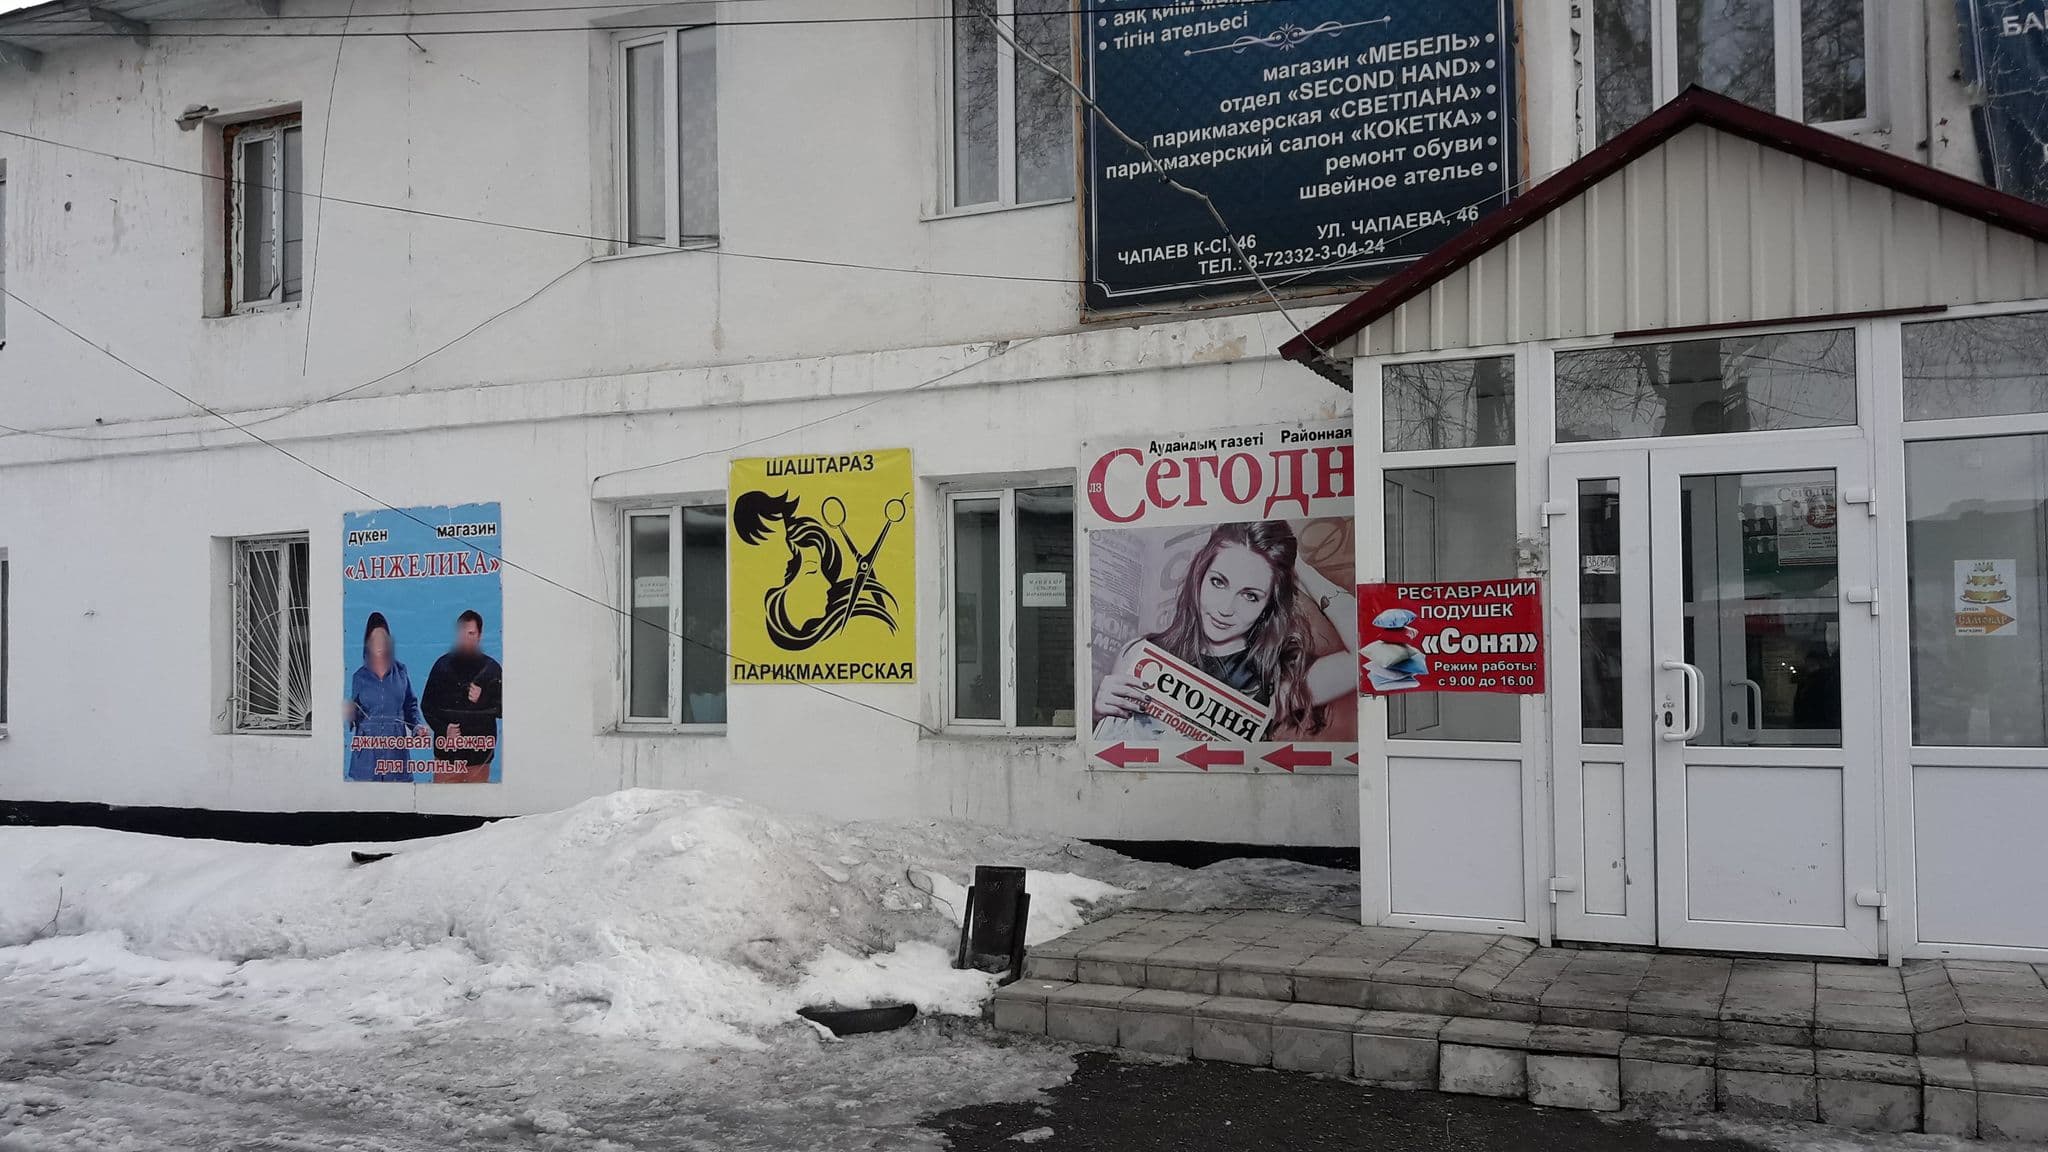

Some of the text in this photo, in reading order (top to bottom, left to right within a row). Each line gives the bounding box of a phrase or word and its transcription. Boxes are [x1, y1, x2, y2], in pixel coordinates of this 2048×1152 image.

[1113, 9, 1147, 26] аяқ
[1114, 11, 1248, 50] тігін ательесі
[1264, 33, 1480, 81] магазин «МЕБЕЛЬ»
[1220, 57, 1480, 113] отдел «SECOND HAND»
[1152, 83, 1481, 148] парикмахерская «СВЕТЛАНА»
[1106, 109, 1481, 179] парикмахерский салон «КОКЕТКА»
[1326, 137, 1483, 175] ремонт обуви
[1300, 161, 1483, 200] швейное ателье
[1317, 206, 1479, 241] УЛ. ЧАПАЕВА, 46
[1118, 243, 1189, 266] ЧАПАЕВ
[1237, 235, 1257, 251] 46
[1198, 239, 1385, 275] ТЕЛ.: 8-72332-3-04-24
[1150, 428, 1352, 456] Аудандық газеті Районная
[766, 454, 875, 477] ШАШТАРАЗ
[437, 523, 496, 537] магазин
[345, 551, 500, 579] «АНЖЕЛИКА»
[1398, 582, 1536, 599] РЕСТАВРАЦИИ
[1421, 604, 1513, 620] ПОДУШЕК
[1421, 627, 1538, 654] «Соня»
[733, 661, 914, 681] ПАРИКМАХЕРСКАЯ
[1434, 660, 1537, 674] Режим работы:
[1449, 676, 1475, 686] 9.00
[1478, 678, 1497, 688] до
[1500, 675, 1534, 686] 16.00
[352, 735, 495, 750] джинсовая одежда
[375, 760, 468, 774] для полных
